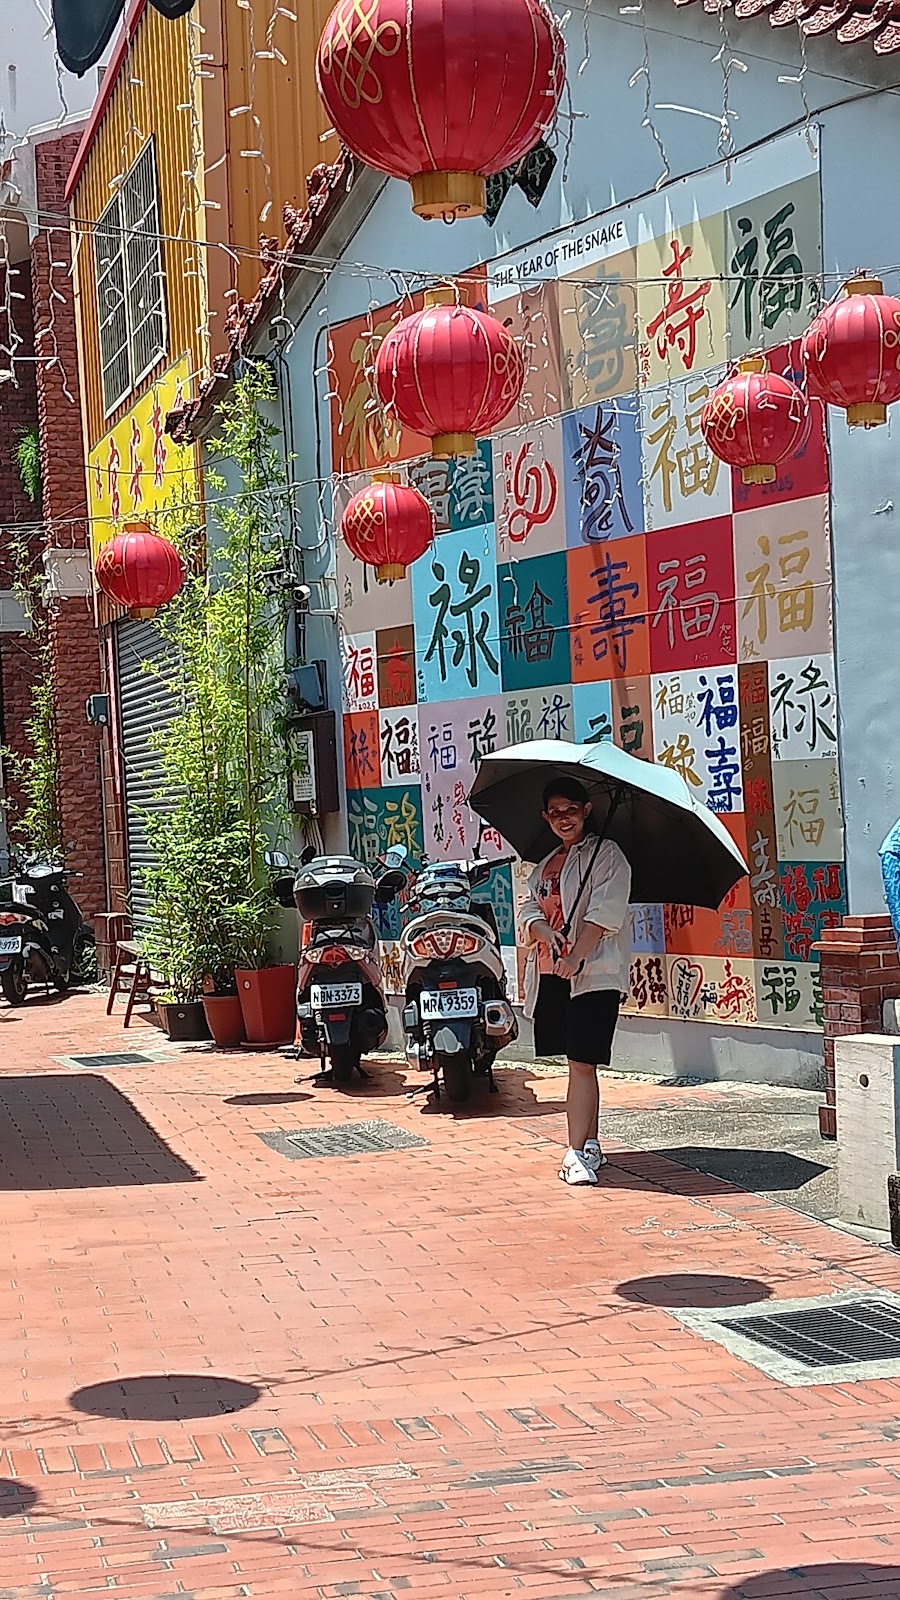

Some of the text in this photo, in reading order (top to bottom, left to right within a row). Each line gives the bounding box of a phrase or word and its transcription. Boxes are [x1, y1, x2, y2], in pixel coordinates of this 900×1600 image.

[494, 221, 623, 288] THE YEAR OF THE SNAKE
[731, 202, 804, 340] 福
[652, 555, 720, 650] 福
[742, 530, 814, 644] 福
[348, 645, 374, 698] 福
[359, 701, 376, 710] 2025
[656, 676, 684, 719] 福
[696, 675, 738, 736] 福
[381, 717, 411, 779] 福
[428, 723, 457, 773] 福
[742, 718, 769, 757] 福
[783, 788, 825, 847] 福
[313, 988, 361, 1003] NBN-3373
[423, 996, 475, 1013] MRA-9359
[700, 982, 718, 1010] 福
[762, 966, 800, 1015] 福
